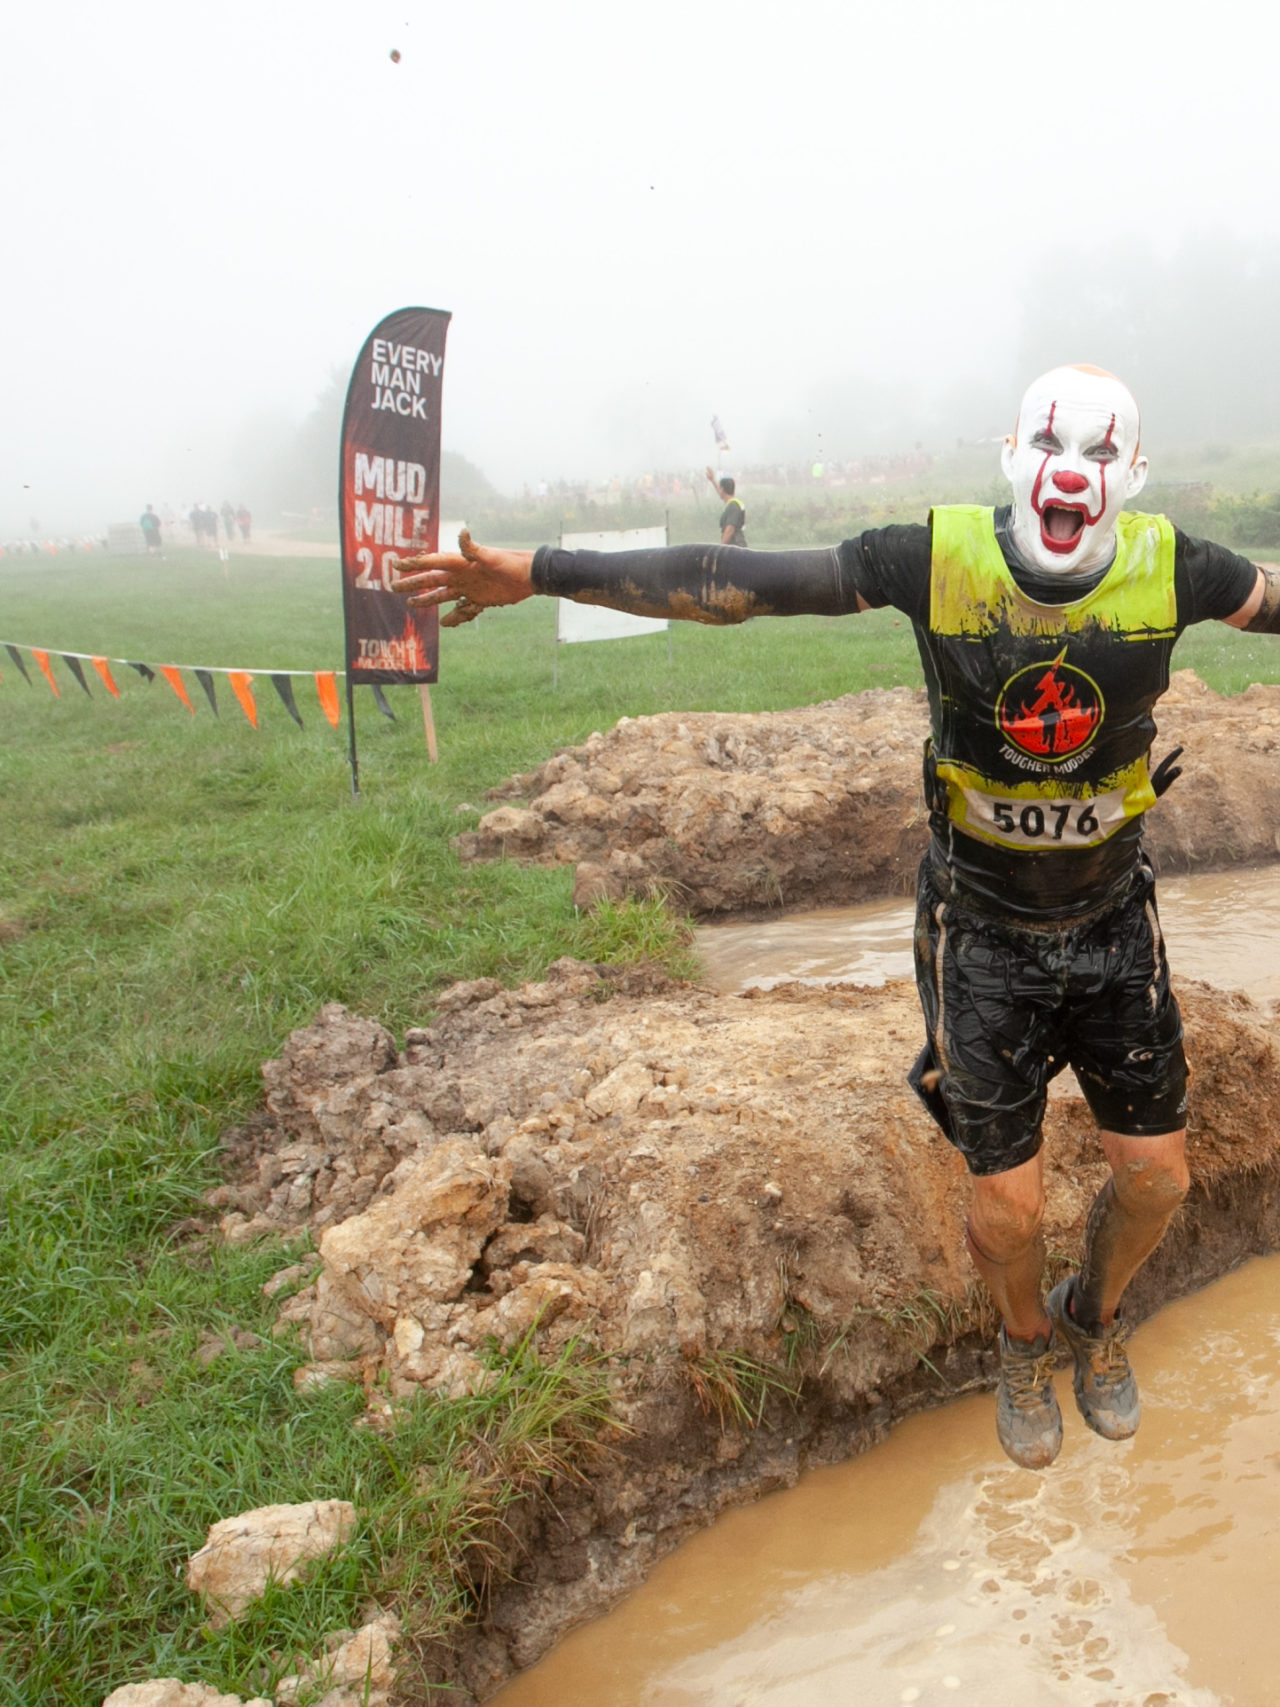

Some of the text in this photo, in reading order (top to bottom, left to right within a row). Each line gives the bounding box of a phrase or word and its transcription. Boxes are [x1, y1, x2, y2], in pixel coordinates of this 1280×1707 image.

[373, 338, 442, 377] EVERY
[371, 361, 421, 395] MAN
[371, 386, 428, 420] JACK
[355, 452, 426, 504] MUD
[355, 500, 429, 549] MILE
[999, 743, 1096, 774] TOUGHER MUDDER
[993, 803, 1099, 840] 5076
